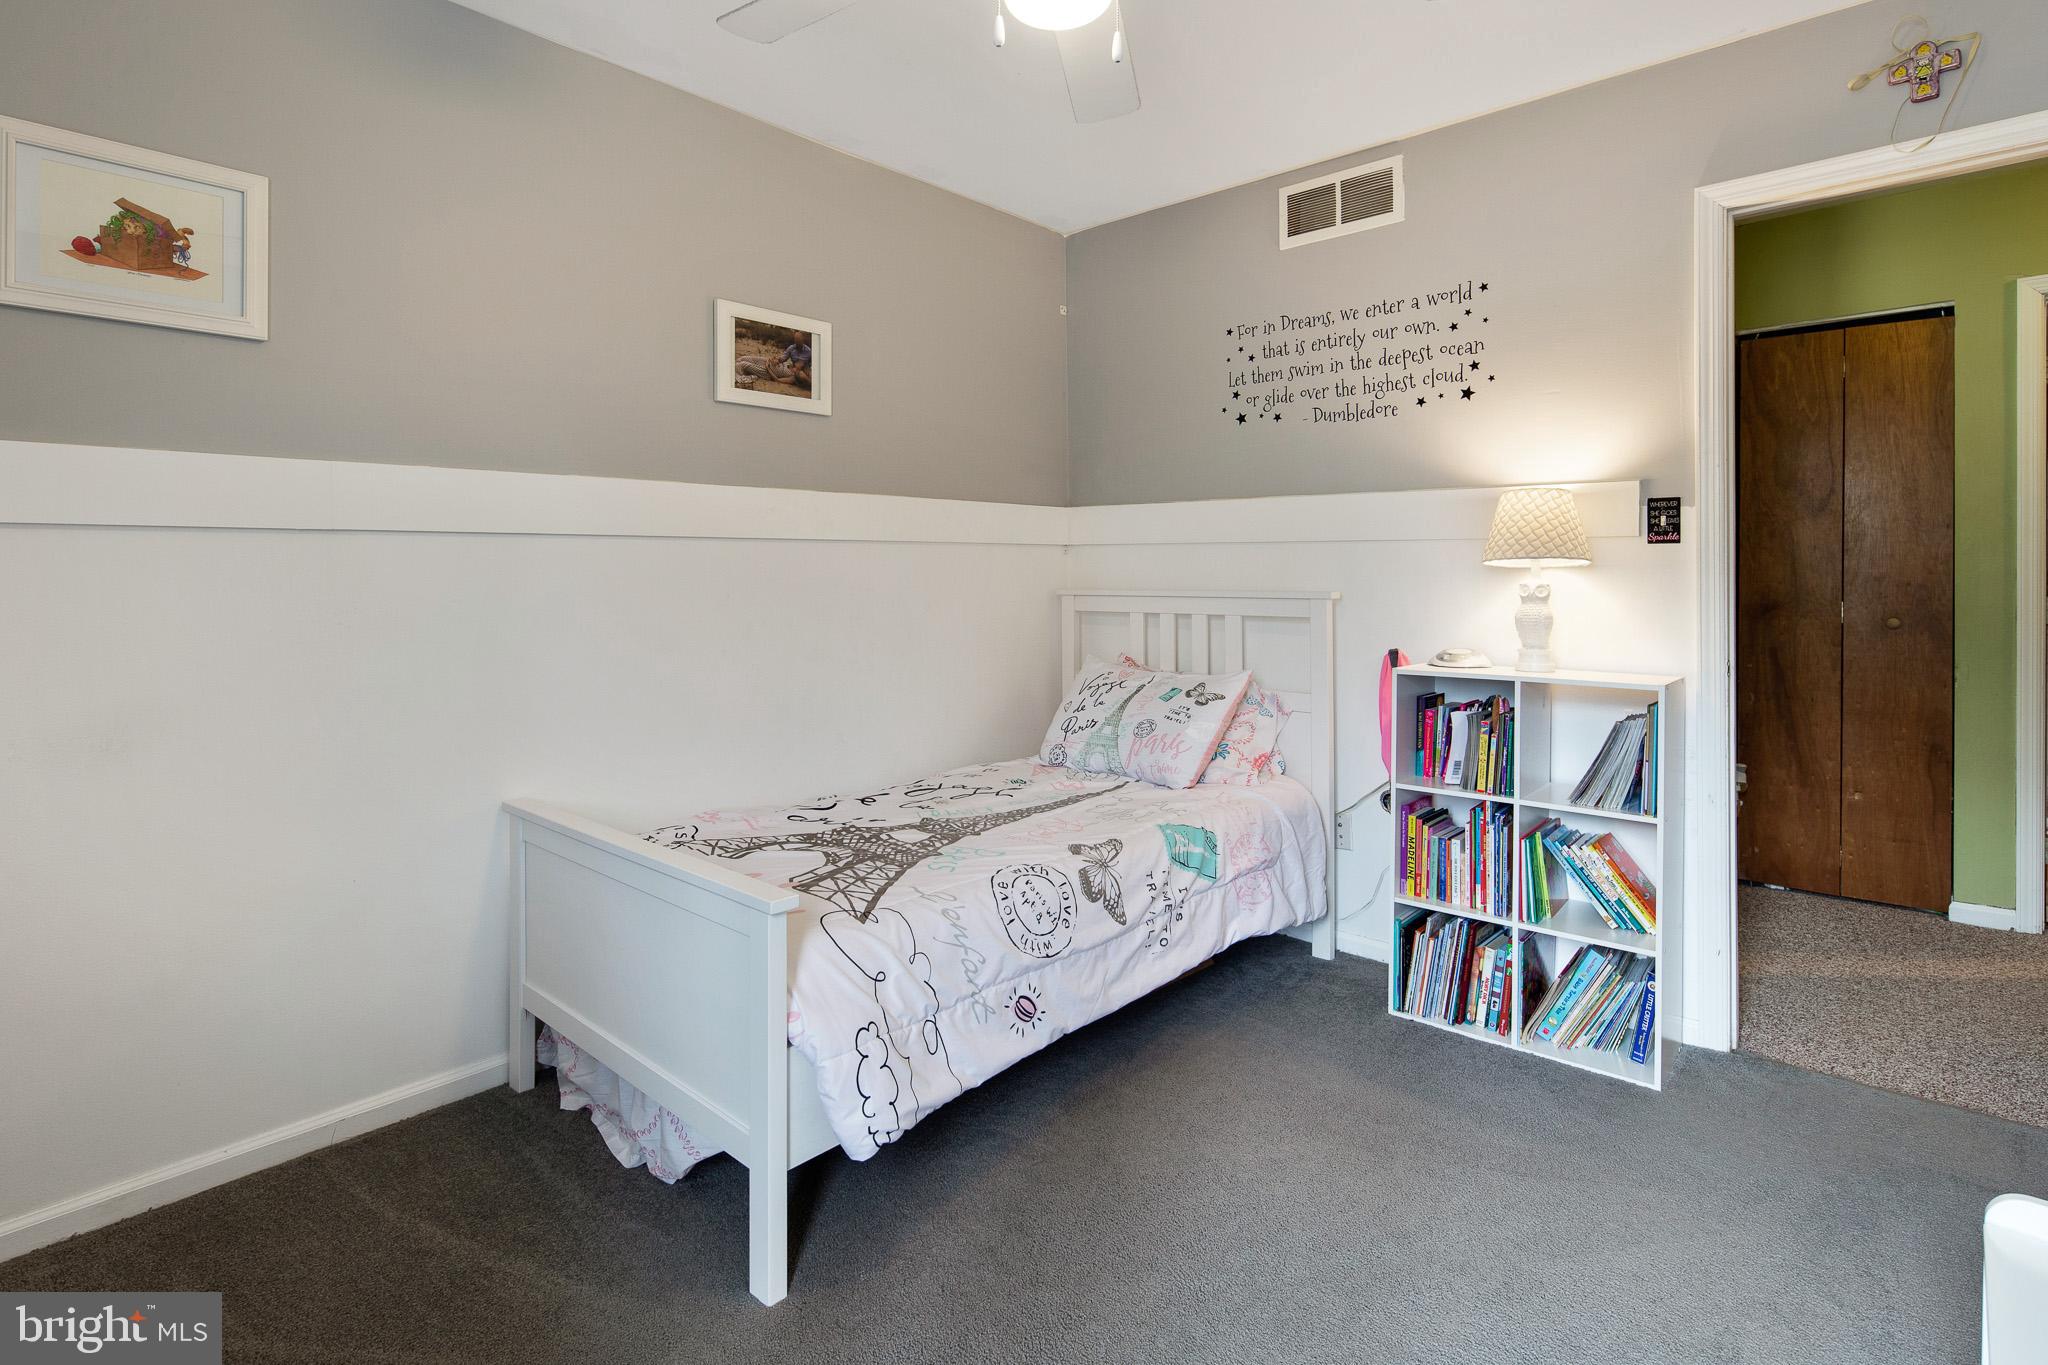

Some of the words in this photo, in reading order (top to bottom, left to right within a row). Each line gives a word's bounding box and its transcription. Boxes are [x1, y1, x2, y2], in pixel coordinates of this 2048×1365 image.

[1237, 324, 1258, 339] For
[1263, 320, 1276, 335] in
[1280, 310, 1335, 331] Dreams,
[1340, 307, 1359, 321] we
[1366, 298, 1404, 317] enter
[1411, 296, 1420, 310] a
[1426, 281, 1472, 306] world
[1262, 340, 1290, 359] that
[1295, 337, 1305, 355] is
[1311, 328, 1365, 351] entirely
[1372, 324, 1398, 339] our
[1404, 320, 1440, 335] own.
[1228, 371, 1247, 388] Let
[1251, 365, 1283, 385] them
[1288, 360, 1324, 381] swim
[1330, 356, 1344, 373] in
[1350, 352, 1372, 371] the
[1378, 345, 1433, 370] deepest
[1439, 338, 1485, 355] ocean
[1246, 393, 1260, 407] or
[1264, 385, 1295, 412] glide
[1300, 384, 1330, 400] over
[1334, 378, 1357, 398] the
[1362, 372, 1416, 400] highest
[1422, 362, 1468, 388] cloud.
[1312, 400, 1399, 424] Dumbledore
[1648, 532, 1679, 542] Sparkle
[1061, 716, 1099, 742] Paris
[1408, 836, 1416, 880] MADELINE
